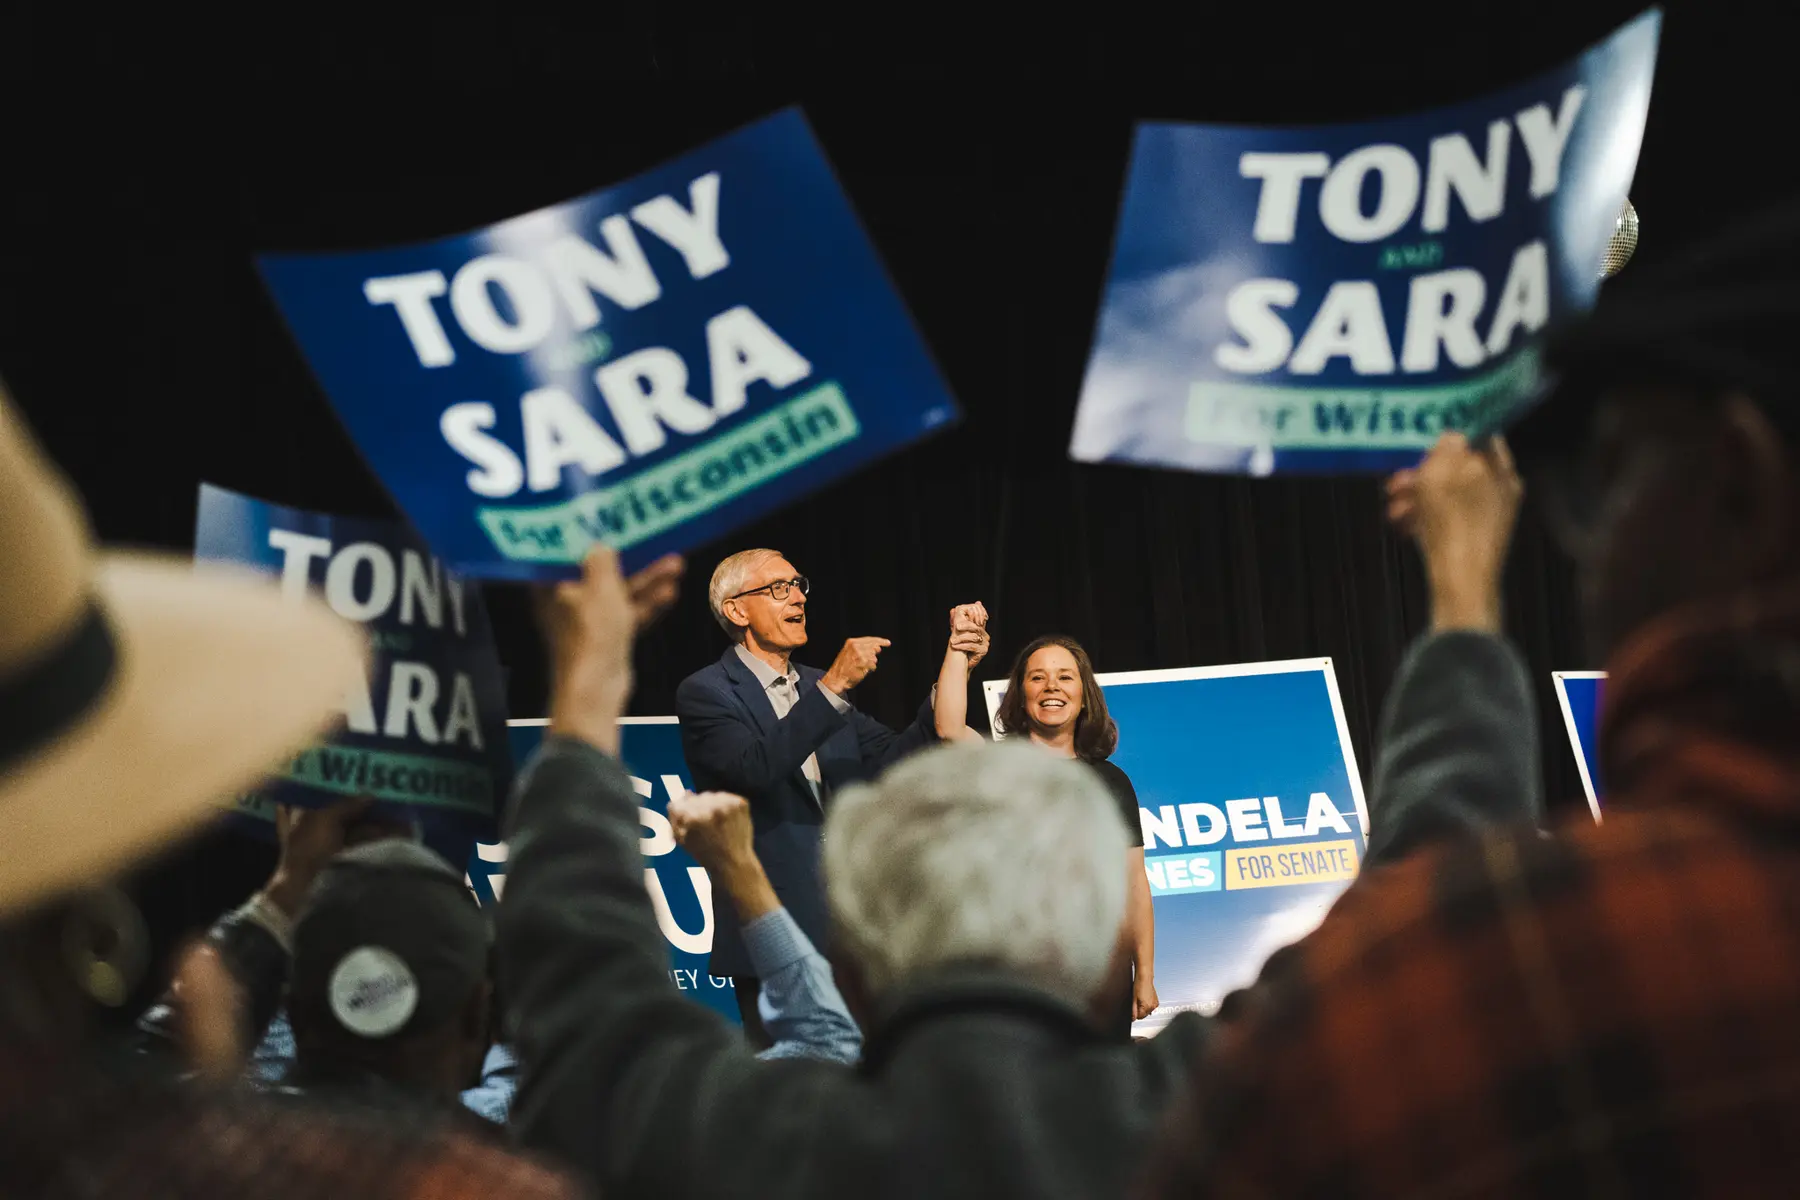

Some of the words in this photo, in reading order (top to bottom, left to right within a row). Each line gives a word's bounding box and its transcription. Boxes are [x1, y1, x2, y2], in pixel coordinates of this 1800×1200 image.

[1240, 84, 1587, 244] TONY
[362, 171, 731, 368] TONY
[1214, 240, 1551, 376] SARA
[440, 305, 813, 498] SARA
[574, 402, 842, 536] Wisconsin
[330, 659, 485, 751] RA
[1236, 855, 1276, 882] FOR
[1276, 847, 1353, 878] SENATE
